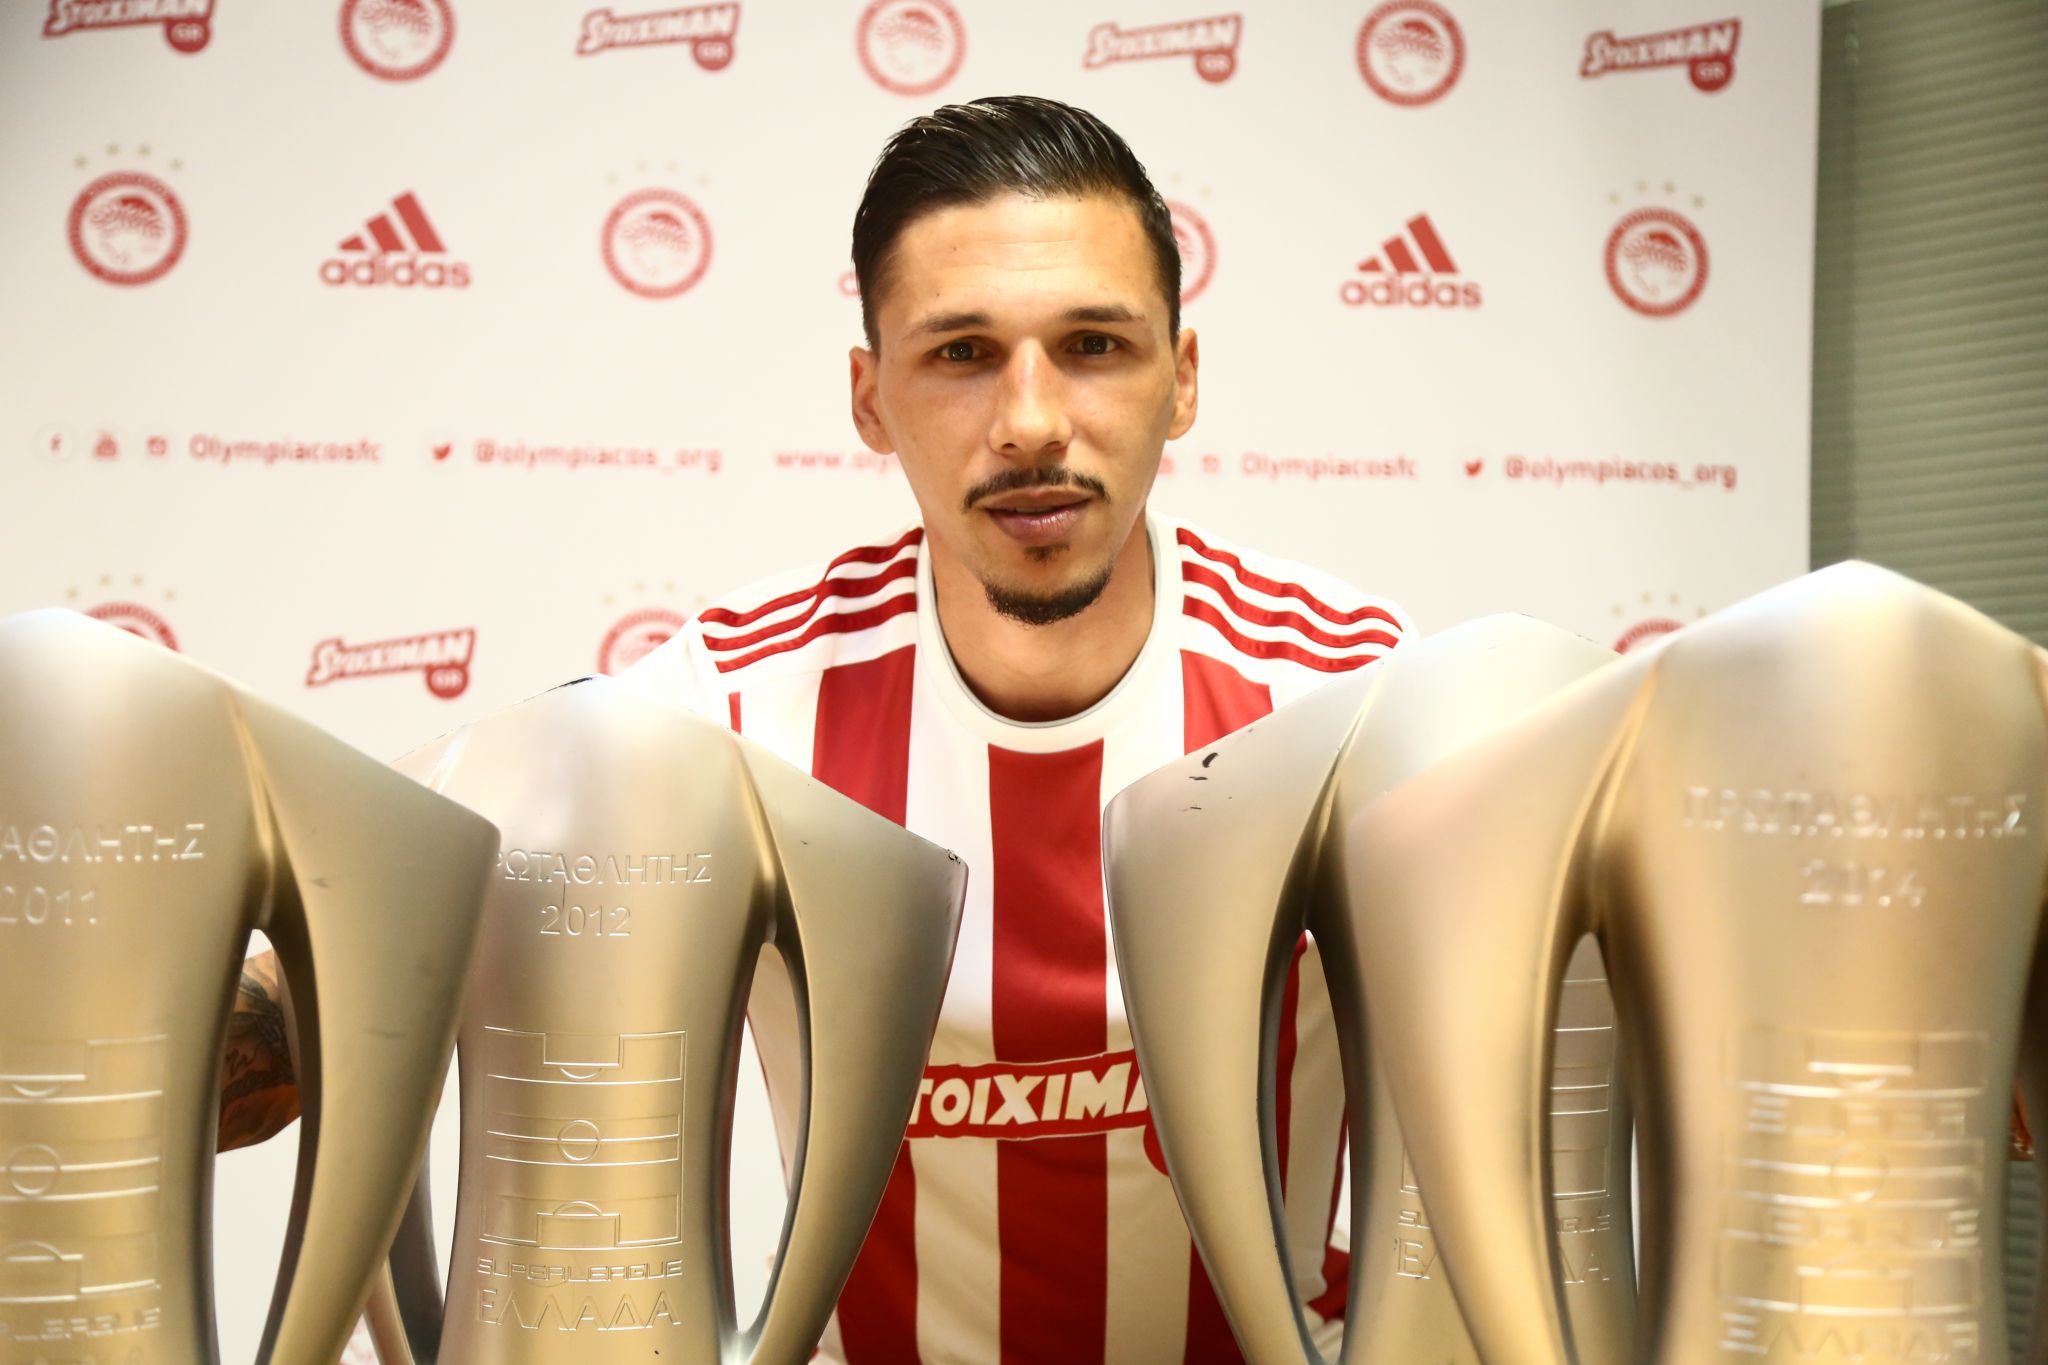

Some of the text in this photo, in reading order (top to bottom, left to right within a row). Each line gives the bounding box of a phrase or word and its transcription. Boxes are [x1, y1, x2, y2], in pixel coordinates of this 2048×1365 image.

[319, 252, 471, 289] adidas
[1340, 275, 1482, 309] adidas
[1504, 455, 1738, 491] @olympiacos_org
[0, 822, 205, 863] ΑΘΛΗΤΗΣ
[540, 905, 632, 937] 2012
[477, 1288, 683, 1331] ΕΛΛΑΔΑ
